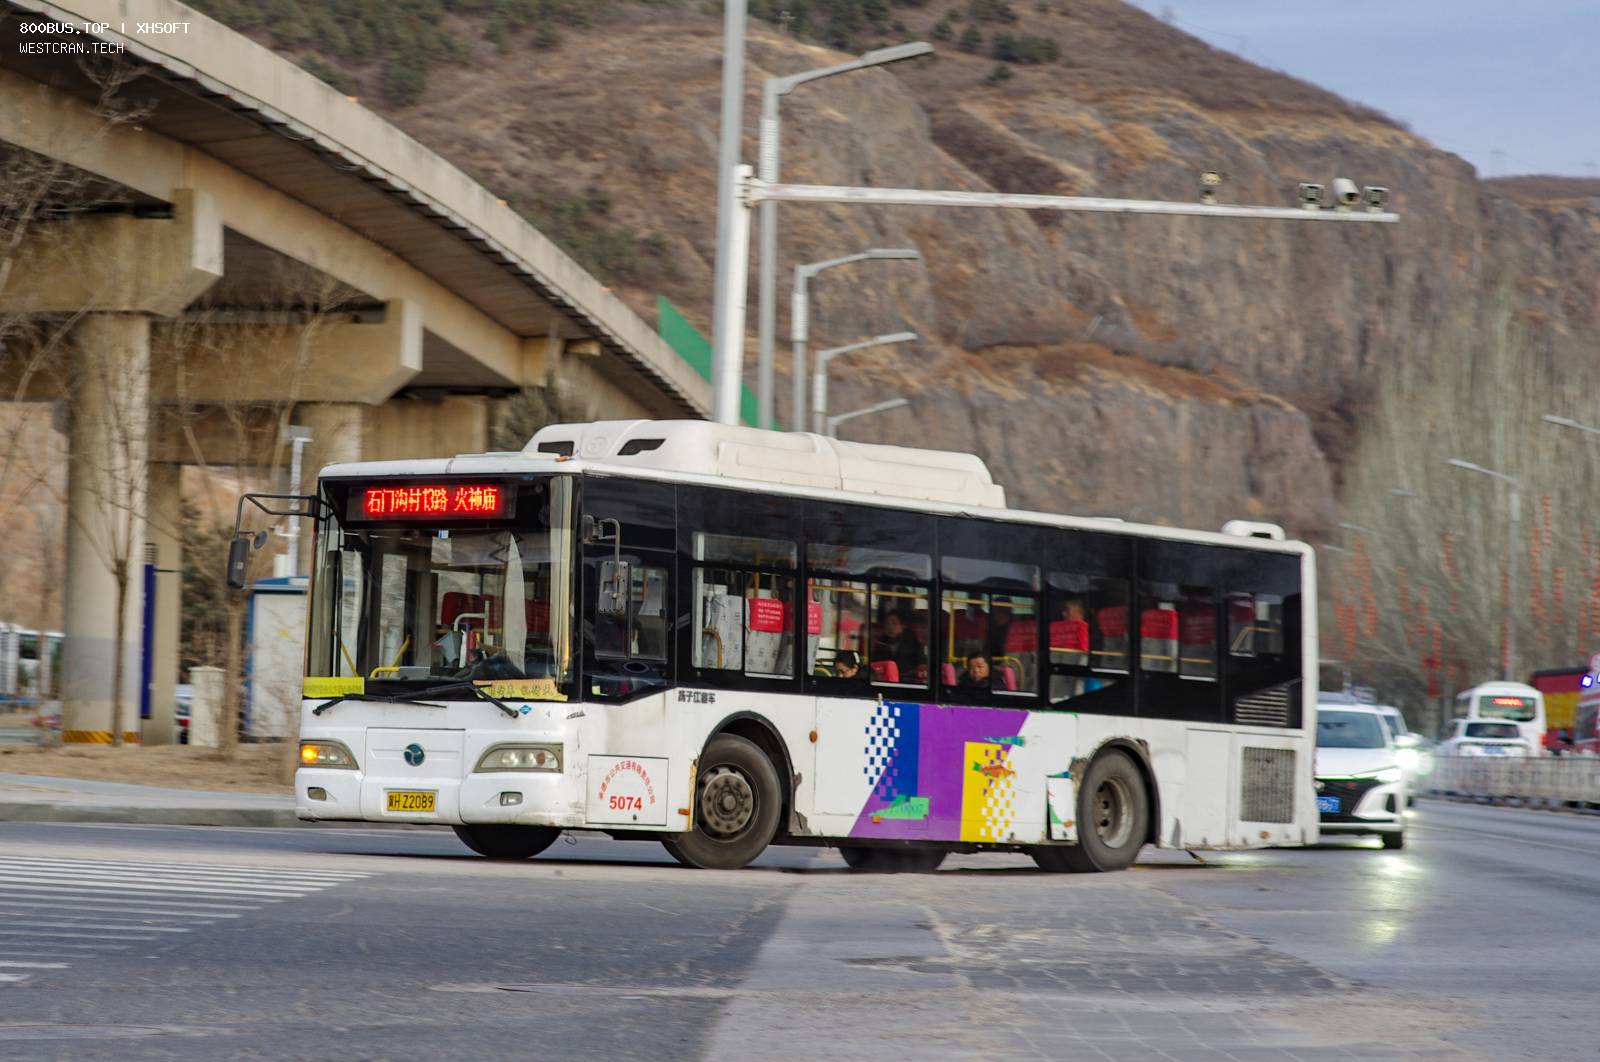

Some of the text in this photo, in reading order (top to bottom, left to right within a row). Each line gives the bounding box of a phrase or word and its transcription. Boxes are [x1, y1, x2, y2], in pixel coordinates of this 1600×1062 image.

[454, 486, 497, 511] 火神庙
[609, 795, 642, 811] 5074
